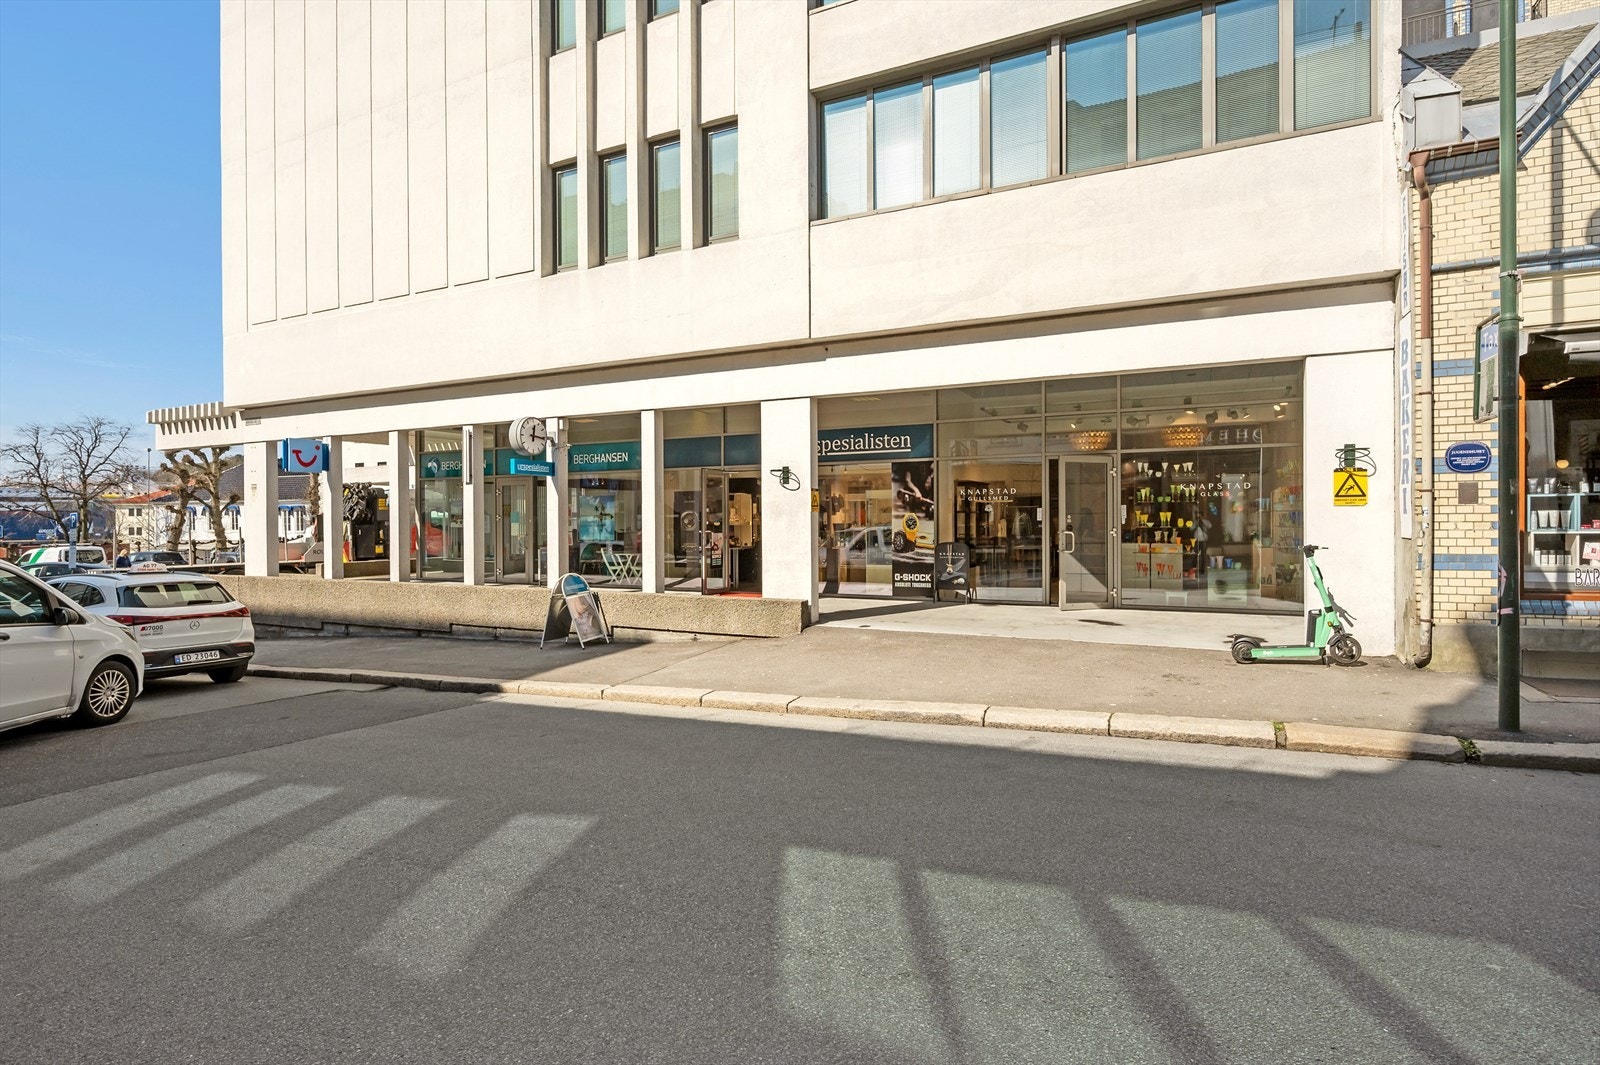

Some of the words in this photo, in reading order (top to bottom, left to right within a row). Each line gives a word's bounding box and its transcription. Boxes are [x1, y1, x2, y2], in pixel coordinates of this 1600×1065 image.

[1482, 332, 1499, 352] Tax
[1401, 338, 1409, 515] BAKERI
[816, 433, 911, 455] spesialisten
[573, 452, 628, 464] BERGHANSEN
[441, 459, 487, 471] BERGHN
[960, 487, 1017, 496] KNAPSTAD
[1180, 482, 1251, 490] KNAPSTAD
[894, 573, 931, 582] G-SHOCK
[1575, 568, 1600, 586] BAR
[181, 654, 192, 662] ED
[194, 651, 218, 660] 23046
